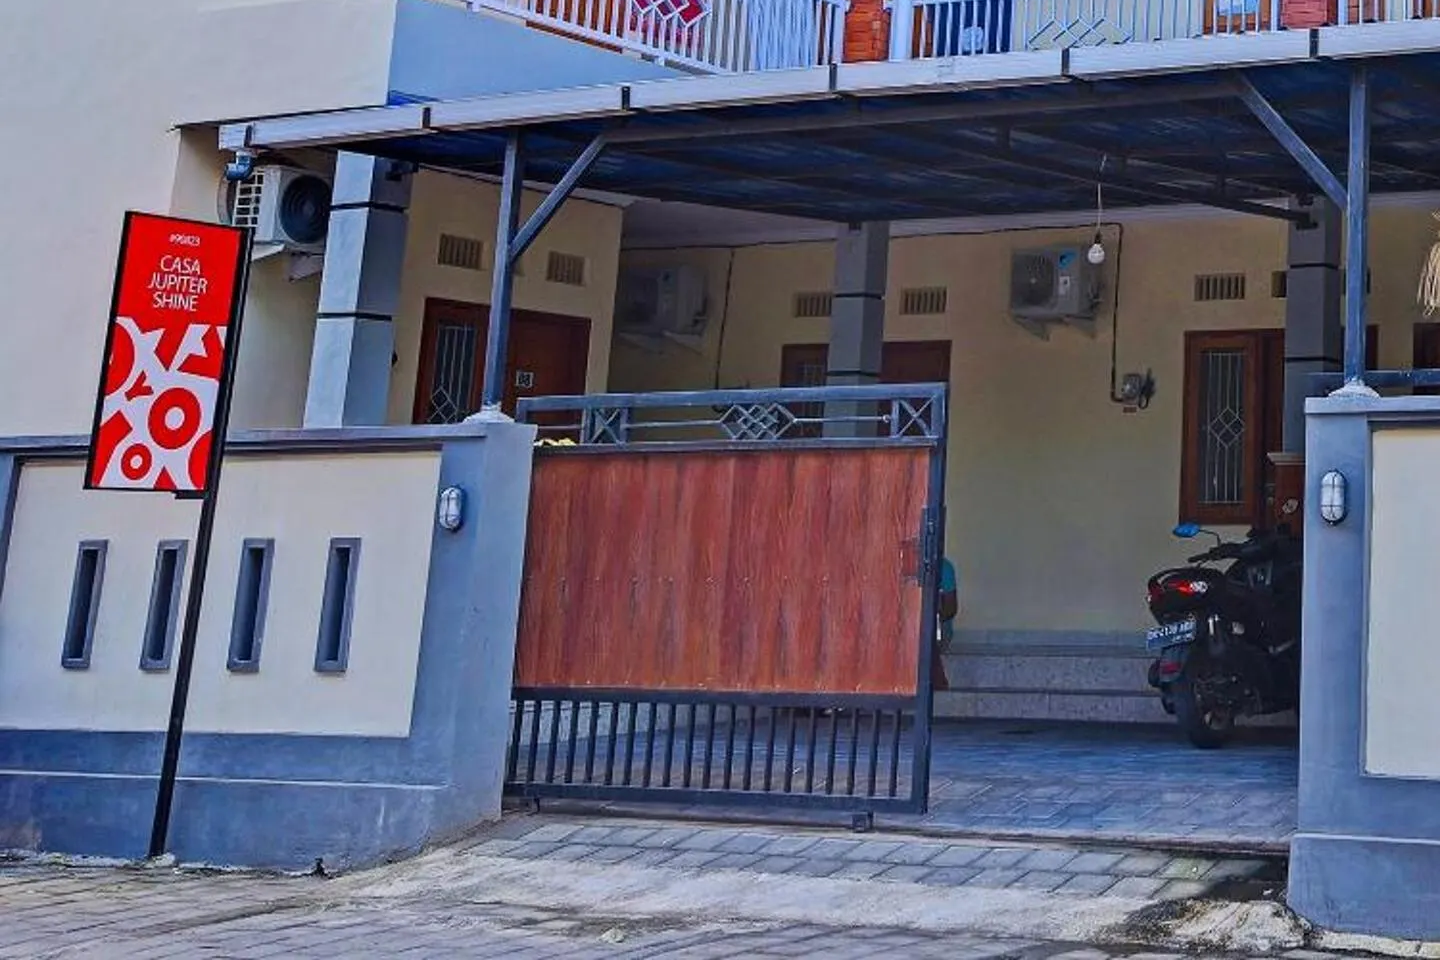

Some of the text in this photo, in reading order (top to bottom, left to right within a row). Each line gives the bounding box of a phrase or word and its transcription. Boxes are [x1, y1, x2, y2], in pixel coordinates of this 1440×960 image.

[160, 254, 201, 276] CASA
[147, 271, 208, 295] JUPITER
[152, 290, 199, 312] SHINE
